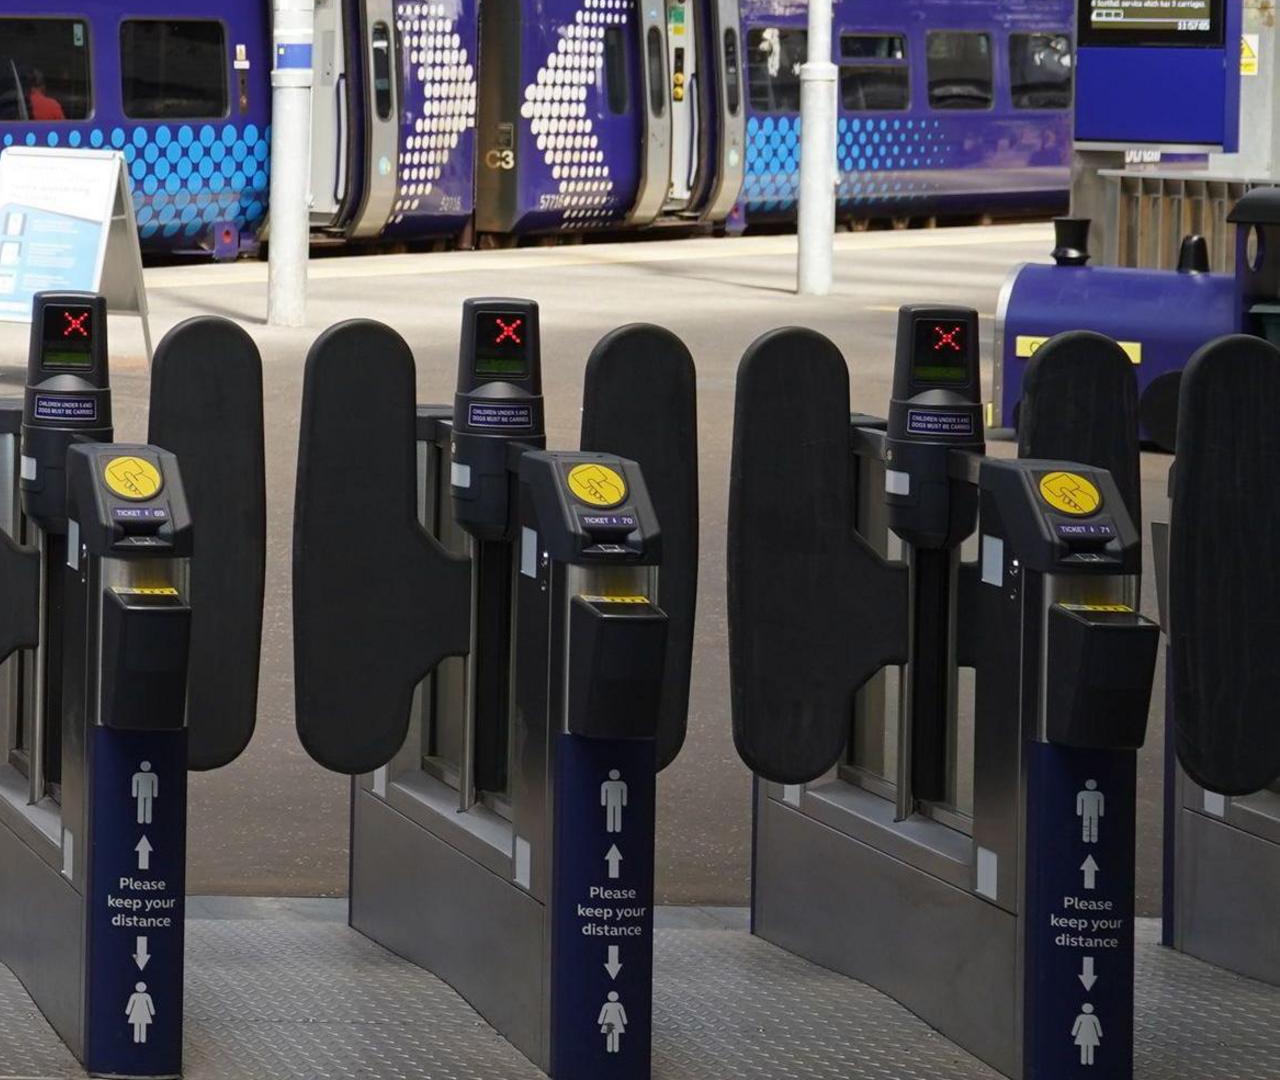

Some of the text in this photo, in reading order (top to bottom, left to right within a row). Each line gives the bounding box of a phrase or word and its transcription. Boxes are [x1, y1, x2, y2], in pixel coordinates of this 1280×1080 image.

[486, 150, 515, 169] C3
[117, 509, 140, 517] TICKET
[622, 517, 633, 525] 70
[120, 877, 166, 890] Please
[590, 886, 636, 899] Please
[108, 894, 176, 911] keep your
[1064, 896, 1113, 910] Please
[578, 904, 646, 921] keep your
[112, 913, 171, 927] distance
[1051, 913, 1123, 932] keep your
[582, 922, 642, 936] distance
[1055, 932, 1119, 948] distance
